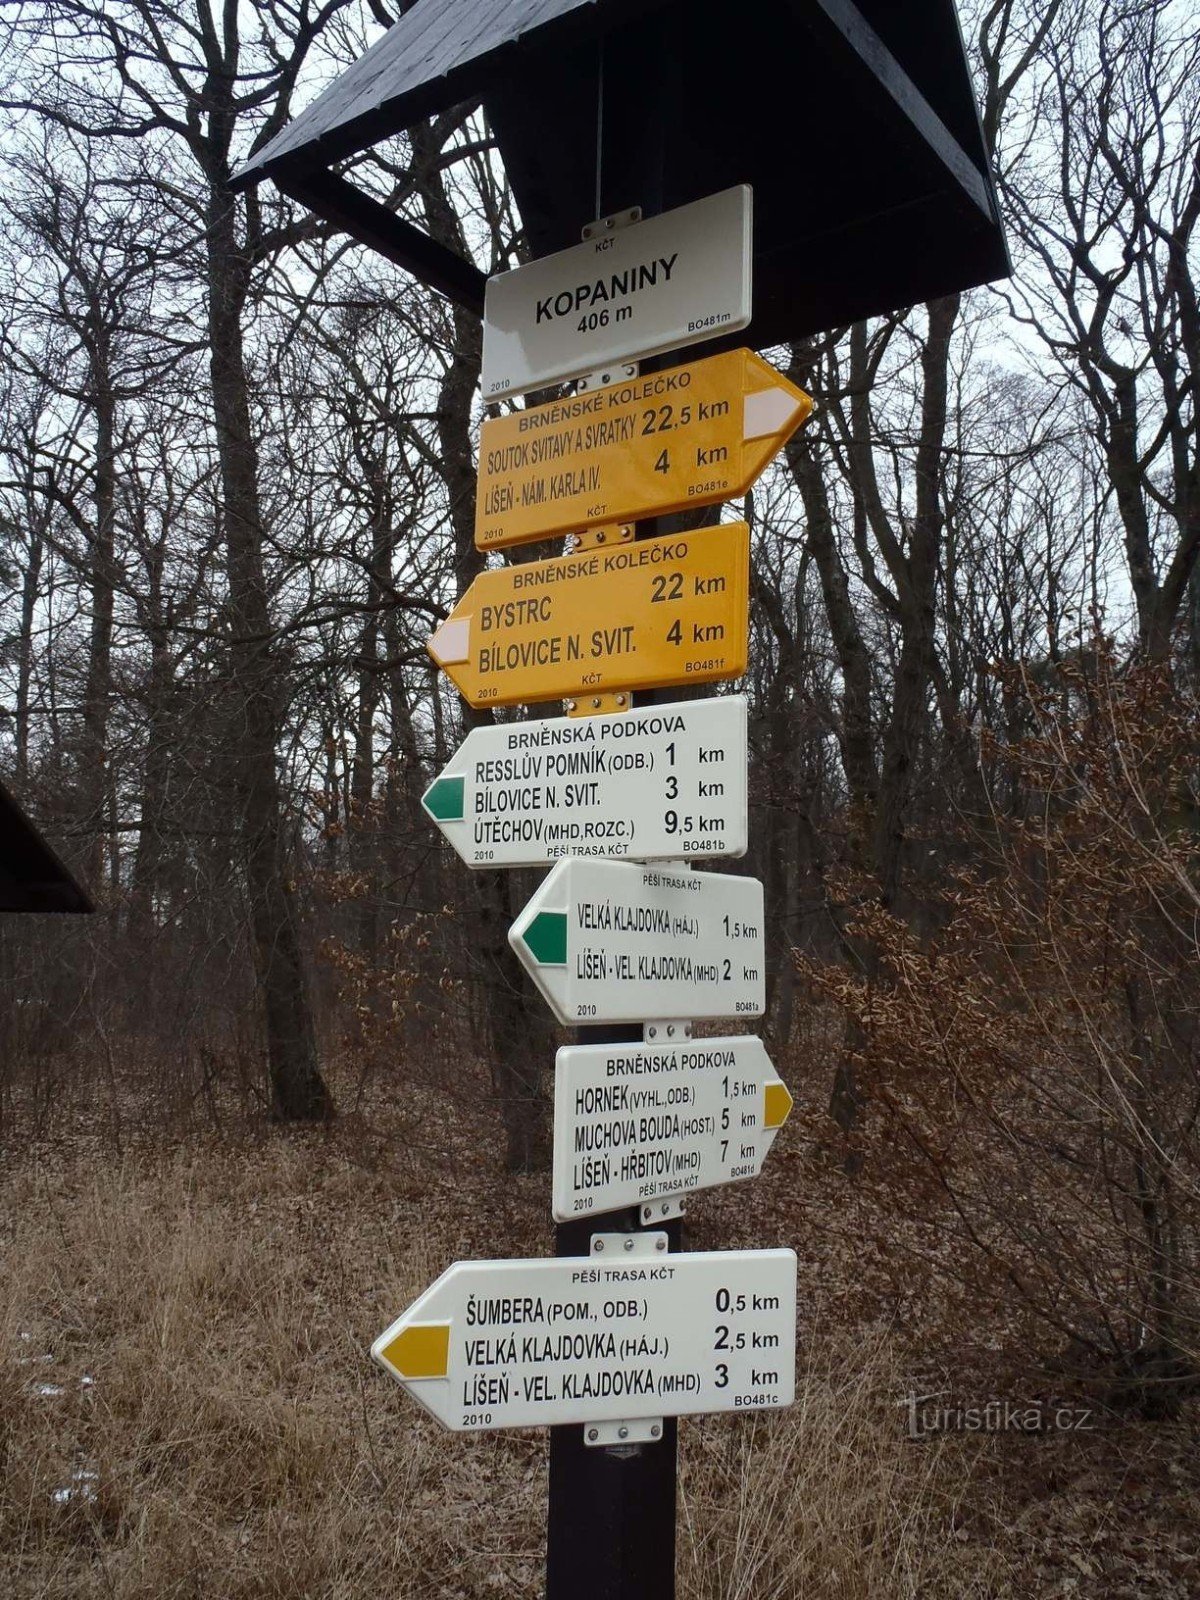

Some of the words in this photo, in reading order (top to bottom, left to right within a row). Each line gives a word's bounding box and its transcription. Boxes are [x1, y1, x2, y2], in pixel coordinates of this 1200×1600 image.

[595, 238, 616, 252] KČT
[536, 254, 678, 323] KOPANINY
[578, 310, 609, 332] 406
[616, 304, 632, 322] m
[490, 379, 510, 392] 2010
[519, 392, 604, 432] BRNĚNSKÉ
[609, 372, 690, 408] KOLEČKO
[488, 443, 528, 476] SOUTOK
[532, 436, 572, 465] SVITAVY
[574, 432, 583, 452] A
[585, 414, 637, 450] SVRATKY
[642, 405, 690, 436] 22,5
[698, 400, 729, 420] km
[484, 484, 514, 516] LÍŠEŇ
[522, 475, 547, 508] NÁM.
[550, 471, 586, 500] KARLA
[654, 450, 670, 474] 4
[697, 446, 728, 466] km
[587, 505, 606, 518] KČT
[484, 528, 504, 540] 2010
[514, 557, 598, 589] BRNĚNSKÉ
[604, 543, 688, 572] KOLEČKO
[481, 596, 552, 631] BYSTRC
[651, 572, 684, 602] 22
[694, 575, 726, 596] km
[479, 638, 561, 674] BÍLOVICE
[567, 634, 584, 660] N.
[590, 626, 636, 656] SVIT.
[666, 620, 682, 646] 4
[693, 623, 724, 643] km
[478, 688, 498, 698] 2010
[582, 673, 602, 685] KČT
[508, 723, 596, 750] BRNĚNSKÁ
[601, 716, 686, 740] PODKOVA
[476, 752, 542, 783] RESSLŮV
[666, 742, 675, 766] 1
[700, 748, 724, 764] km
[475, 784, 540, 814] BÍLOVICE
[546, 786, 560, 809] N.
[565, 782, 601, 807] SVIT.
[665, 776, 678, 800] 3
[699, 780, 724, 797] km
[664, 810, 693, 836] 9,5
[700, 815, 724, 832] km
[474, 850, 494, 860] 2010
[547, 846, 570, 858] PĚŠÍ
[572, 845, 606, 856] TRASA
[608, 842, 628, 854] KČT
[643, 874, 661, 886] PĚŠÍ
[662, 877, 686, 889] TRASA
[688, 880, 701, 891] KČT
[578, 899, 611, 930] VELKÁ
[615, 906, 670, 933] KLAJDOVKA
[723, 915, 740, 939] 1,5
[743, 923, 757, 939] km
[577, 948, 607, 979] LÍŠEŇ
[615, 955, 636, 980] VEL.
[723, 959, 731, 981] 2
[744, 967, 758, 981] km
[577, 1005, 597, 1015] 2010
[607, 1051, 678, 1076] BRNĚNSKÁ
[682, 1051, 736, 1070] PODKOVA
[722, 1076, 739, 1100] 1,5
[742, 1081, 756, 1096] km
[574, 1120, 636, 1153] MUCHOVA
[722, 1108, 729, 1129] 5
[741, 1113, 756, 1126] km
[574, 1152, 610, 1191] LÍŠEŇ
[721, 1140, 729, 1162] 7
[741, 1144, 755, 1159] km
[639, 1184, 657, 1197] PĚŠÍ
[659, 1180, 682, 1193] TRASA
[684, 1175, 699, 1187] KČT
[574, 1197, 593, 1210] 2010
[572, 1269, 600, 1284] PĚŠÍ
[605, 1269, 646, 1282] TRASA
[650, 1267, 675, 1279] KČT
[603, 1300, 648, 1321] ODB.)
[715, 1288, 746, 1315] 0,5
[752, 1294, 779, 1311] km
[465, 1332, 517, 1366] VELKÁ
[522, 1332, 616, 1363] KLAJDOVKA
[620, 1337, 669, 1361] (HÁJ.)
[713, 1326, 746, 1352] 2,5
[752, 1332, 779, 1348] km
[463, 1372, 509, 1406] LÍŠEŇ
[523, 1376, 557, 1402] VEL.
[714, 1363, 729, 1388] 3
[751, 1369, 778, 1386] km
[463, 1413, 492, 1426] 2010
